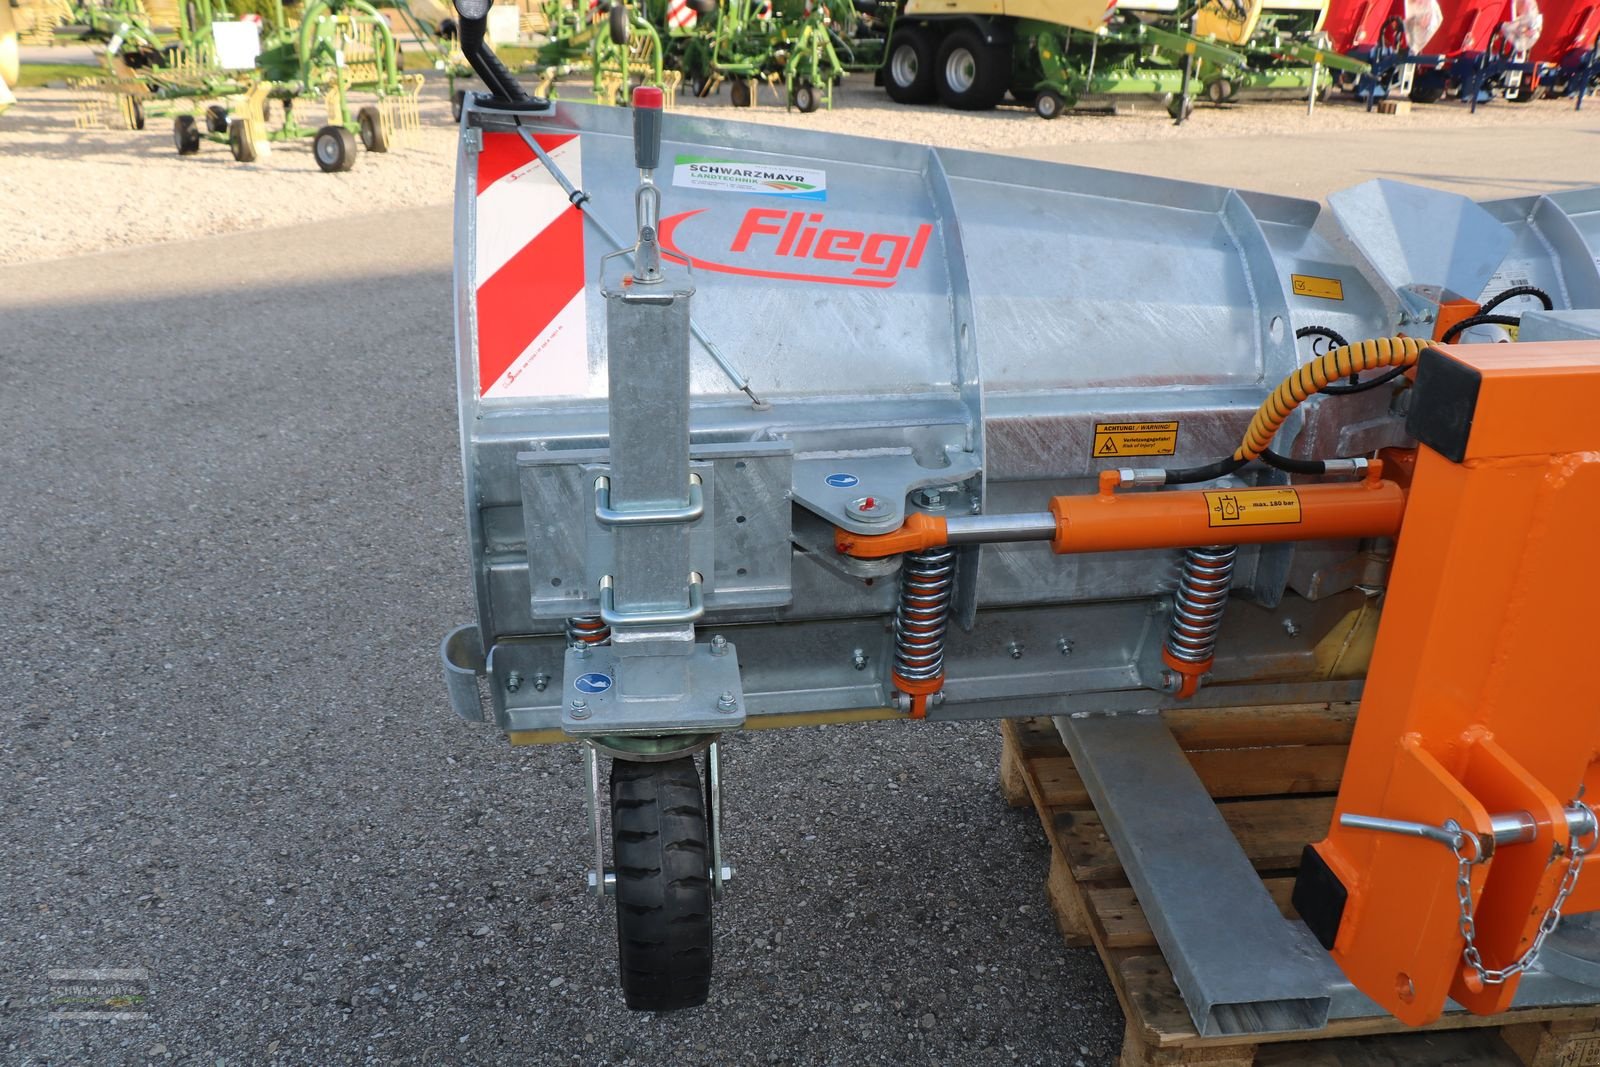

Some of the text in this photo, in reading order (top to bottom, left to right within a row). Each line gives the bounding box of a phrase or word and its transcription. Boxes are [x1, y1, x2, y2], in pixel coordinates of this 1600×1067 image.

[689, 164, 805, 182] SCHWARZMAYR
[690, 172, 758, 184] LANDTECHNIK
[729, 207, 934, 279] Fliegl
[1140, 423, 1171, 431] WARNING!
